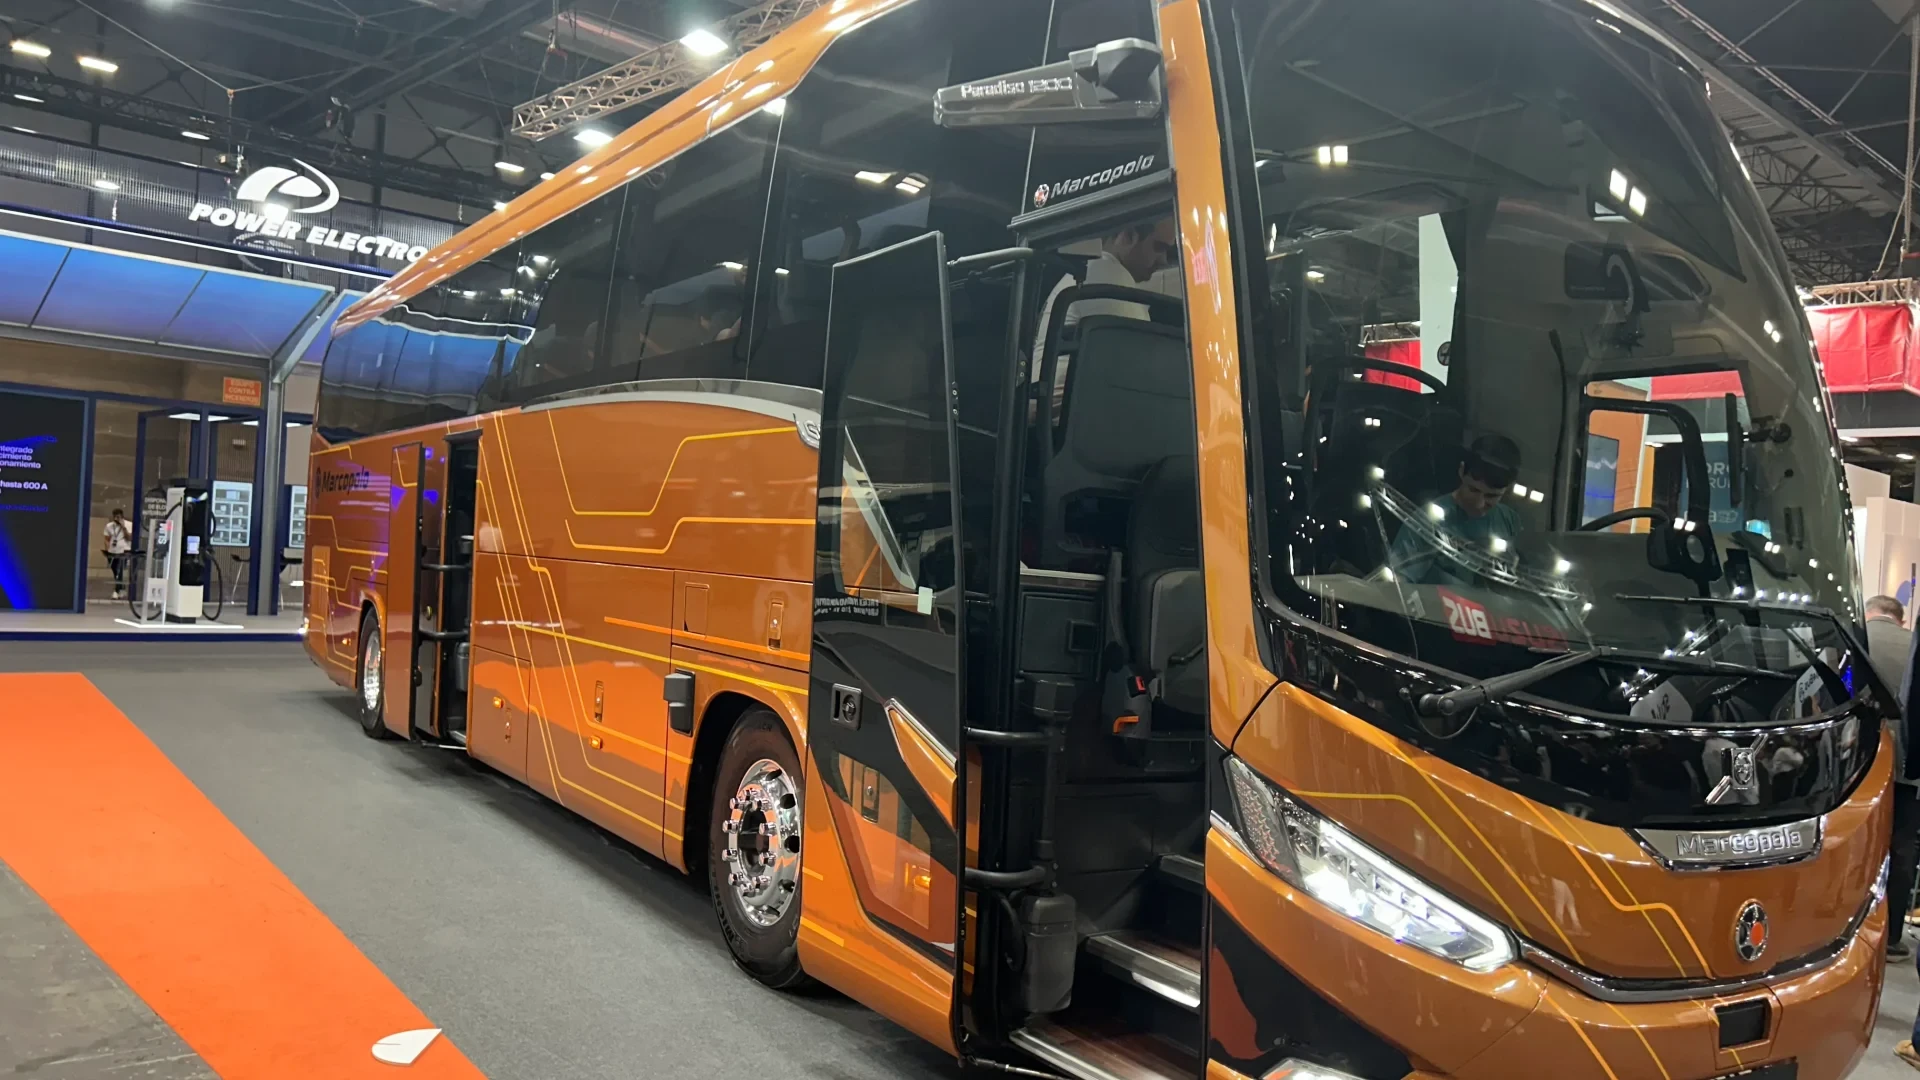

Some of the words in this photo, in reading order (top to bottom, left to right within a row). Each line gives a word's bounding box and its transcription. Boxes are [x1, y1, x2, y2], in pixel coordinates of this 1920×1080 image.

[1028, 76, 1073, 93] 1200
[1050, 154, 1155, 199] Marcopolo
[188, 202, 301, 241] POWER
[306, 225, 428, 263] ELECTRO
[228, 386, 256, 396] CONTRA
[0, 480, 22, 489] hasta
[23, 481, 41, 490] 600
[321, 465, 370, 496] Marcopolo
[1675, 827, 1804, 856] Marcopolo
